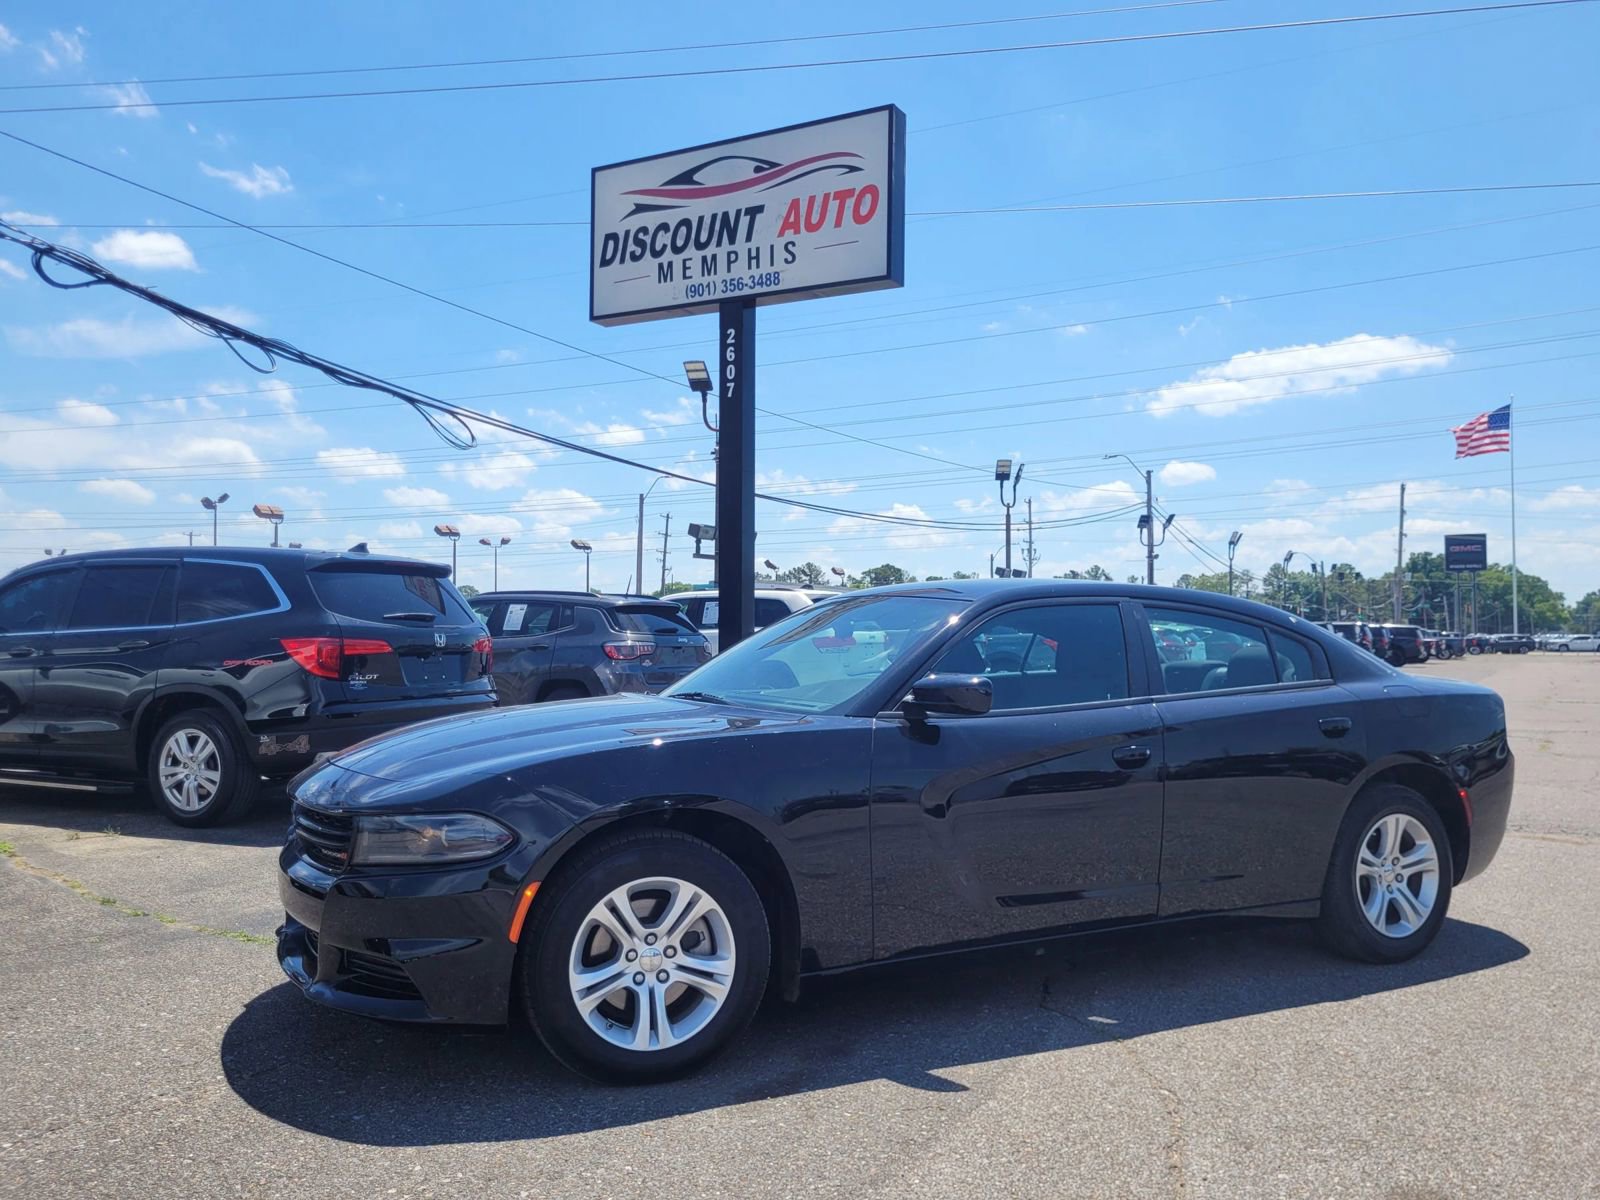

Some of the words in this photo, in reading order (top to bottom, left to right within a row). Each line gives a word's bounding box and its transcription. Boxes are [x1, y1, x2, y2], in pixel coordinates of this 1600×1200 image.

[599, 204, 766, 268] DISCOUNT
[777, 184, 880, 238] AUTO
[657, 240, 797, 284] MEMPHIS
[685, 281, 717, 299] (901)
[721, 271, 781, 294] 356-3488
[726, 328, 736, 398] 2607
